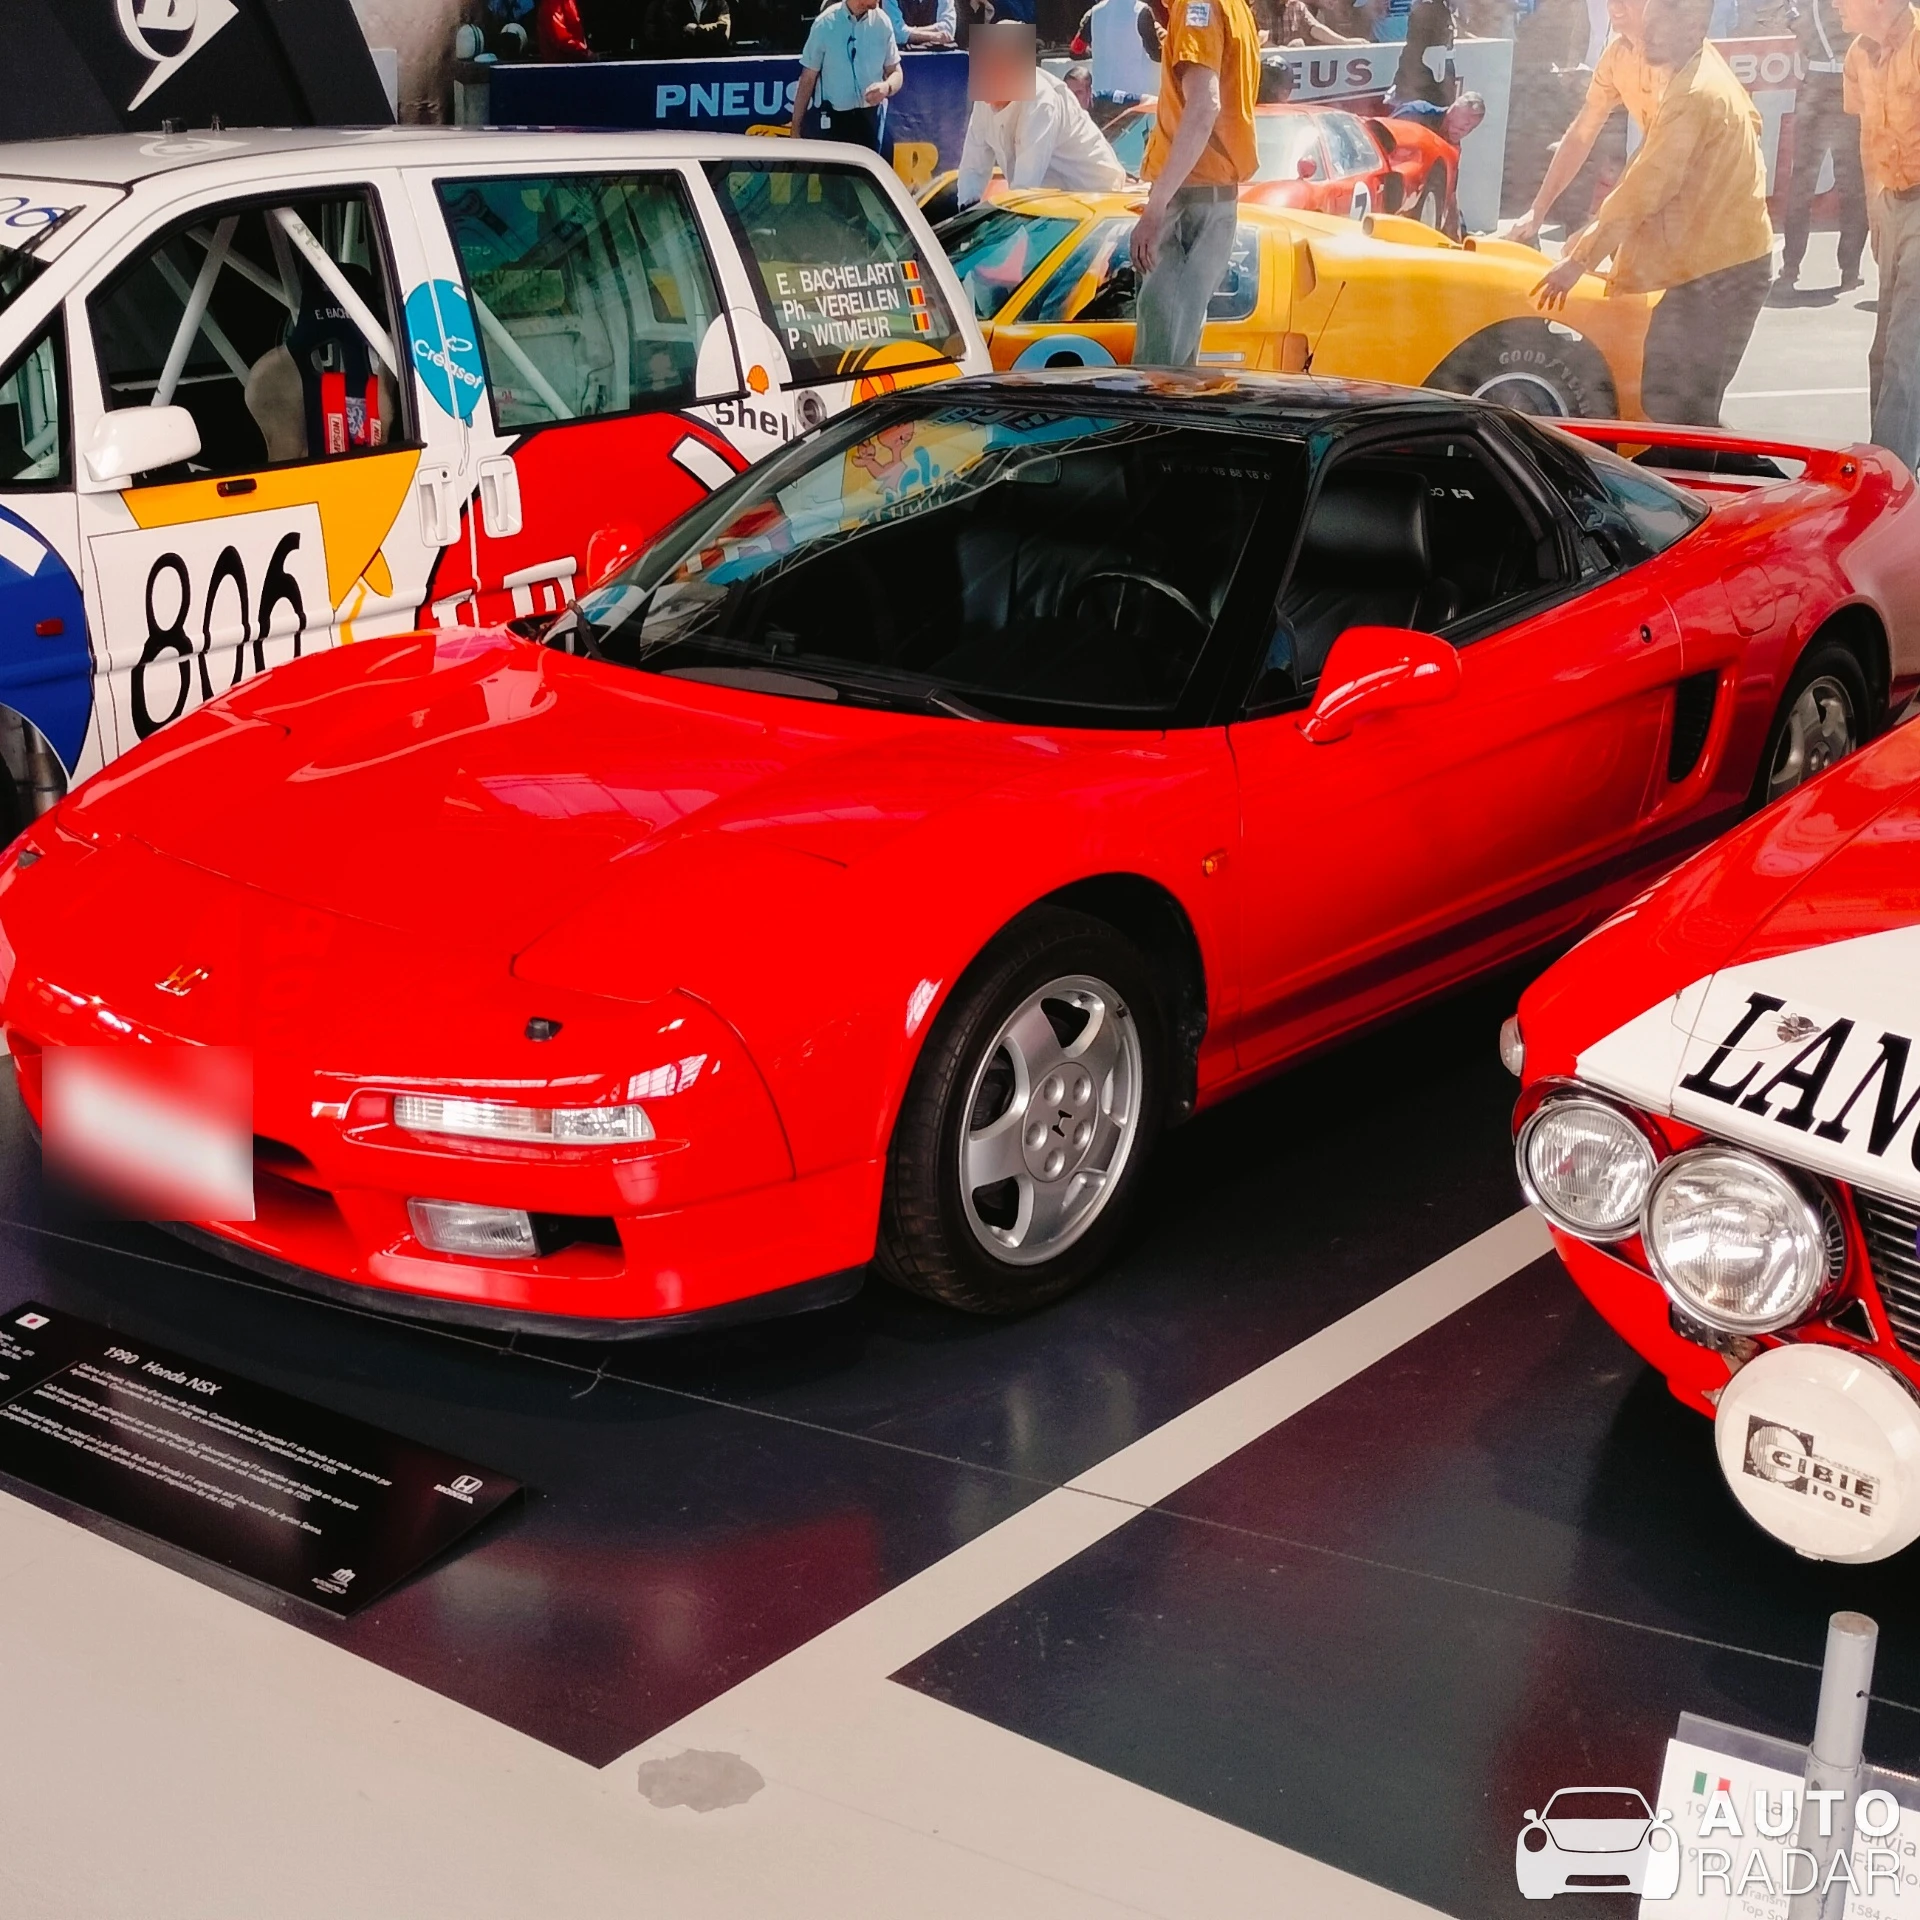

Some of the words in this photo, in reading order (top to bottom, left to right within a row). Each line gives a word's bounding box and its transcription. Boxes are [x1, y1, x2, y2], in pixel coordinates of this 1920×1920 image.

[776, 273, 796, 296] E.
[800, 262, 895, 293] BACHELART
[782, 299, 811, 323] Ph.
[815, 288, 901, 318] VERELLEN
[787, 328, 808, 350] P.
[811, 316, 892, 347] WITMEUR
[131, 531, 307, 740] 806
[103, 1346, 140, 1365] 1990
[141, 1360, 187, 1385] Honda
[185, 1377, 223, 1396] NSX
[1812, 1484, 1872, 1517] IODE
